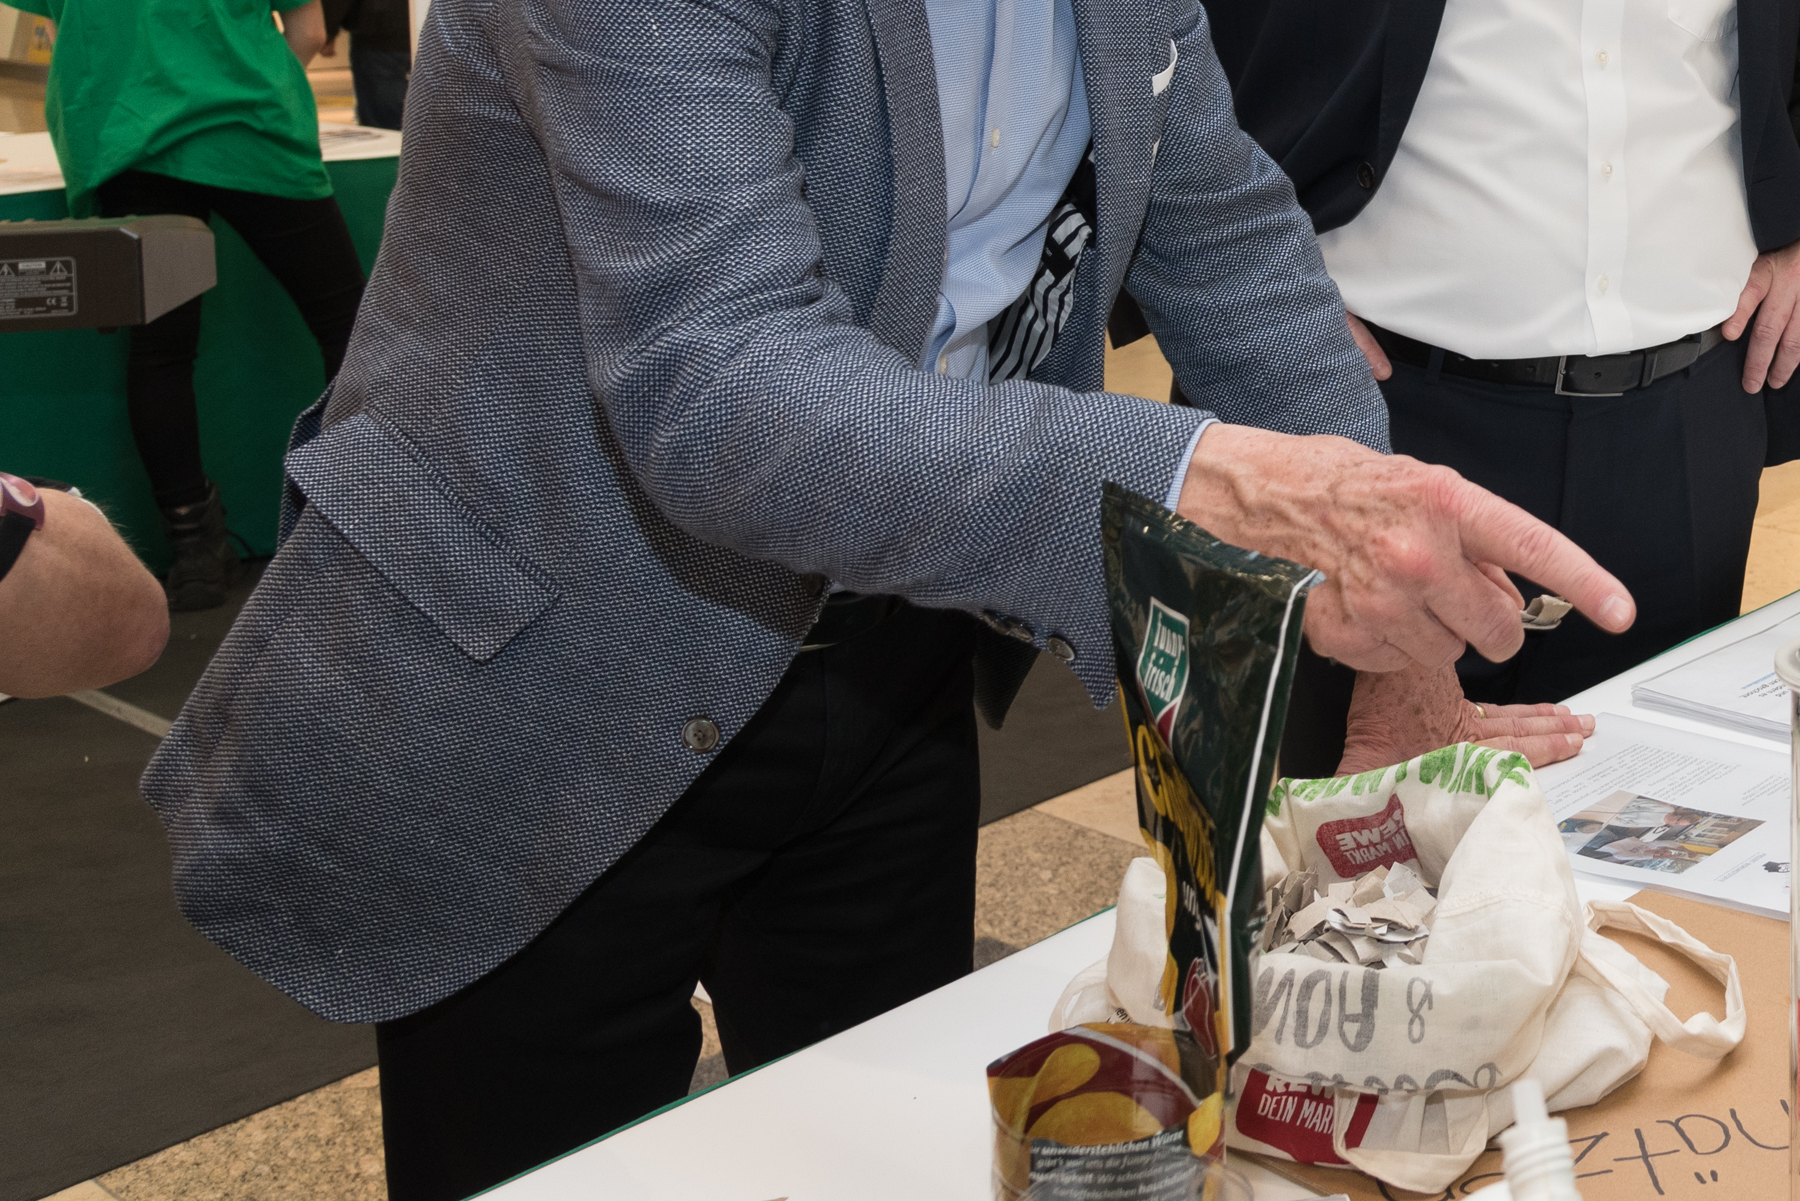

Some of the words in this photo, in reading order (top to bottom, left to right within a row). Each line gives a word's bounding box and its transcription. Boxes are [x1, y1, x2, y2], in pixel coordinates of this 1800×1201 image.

[1153, 611, 1185, 666] funny-
[1144, 652, 1177, 703] frisch
[1257, 1093, 1299, 1124] DEIN
[1041, 1140, 1150, 1156] unwiderstehlichen
